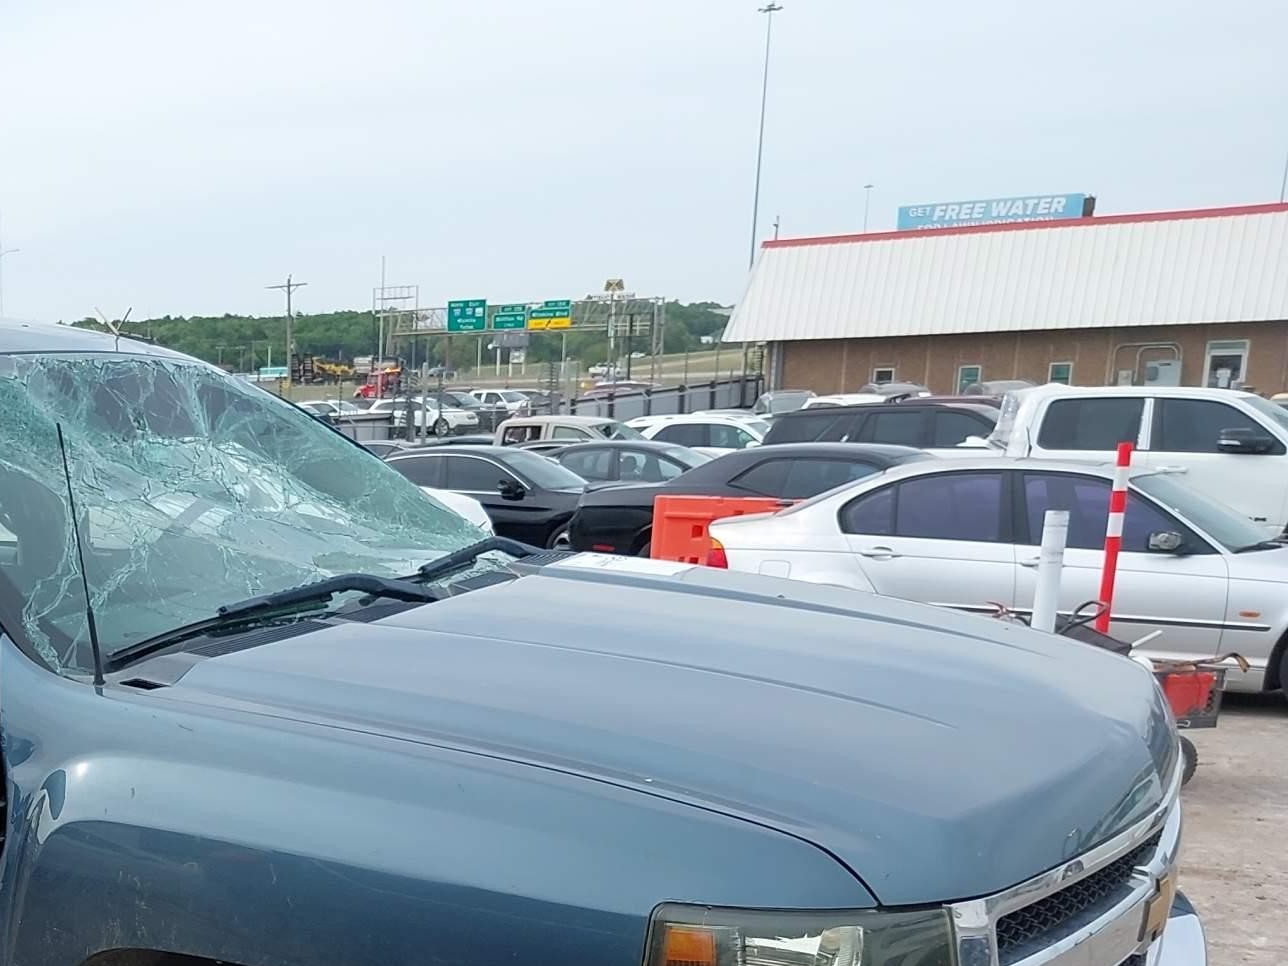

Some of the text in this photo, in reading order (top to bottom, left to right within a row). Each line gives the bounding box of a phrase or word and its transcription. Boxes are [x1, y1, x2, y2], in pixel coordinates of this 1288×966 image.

[909, 196, 1066, 221] GET FREE WATER
